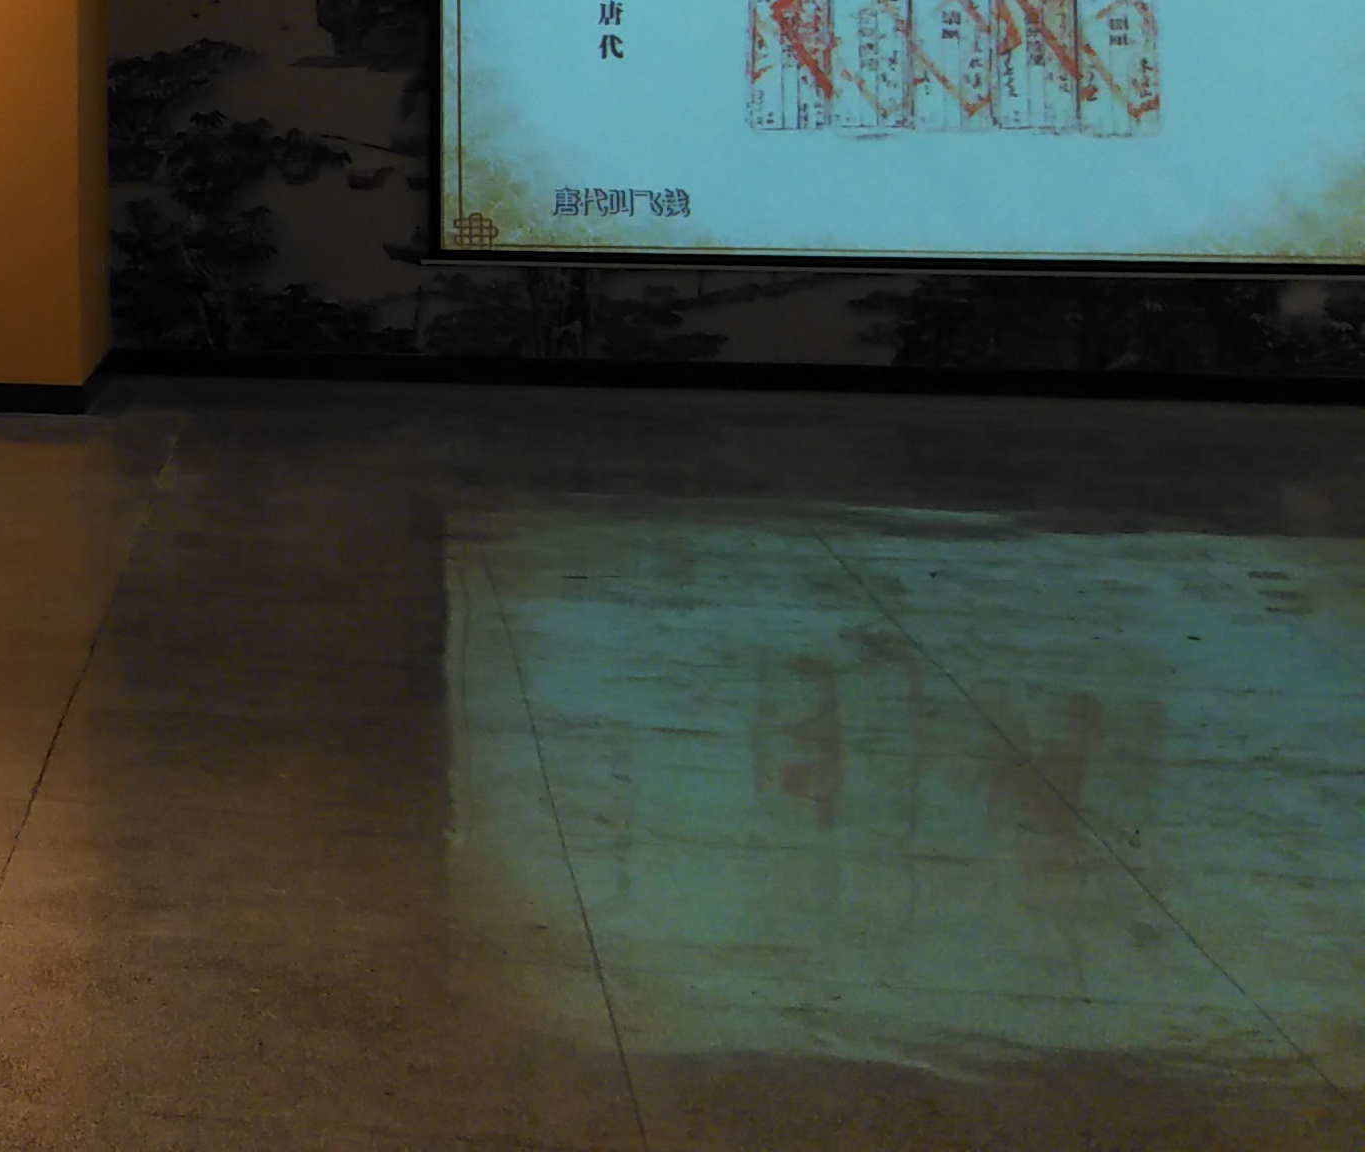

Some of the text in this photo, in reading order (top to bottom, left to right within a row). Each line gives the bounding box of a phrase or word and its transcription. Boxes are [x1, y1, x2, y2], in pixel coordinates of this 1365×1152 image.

[552, 186, 691, 218] 唐代叫飞钱
